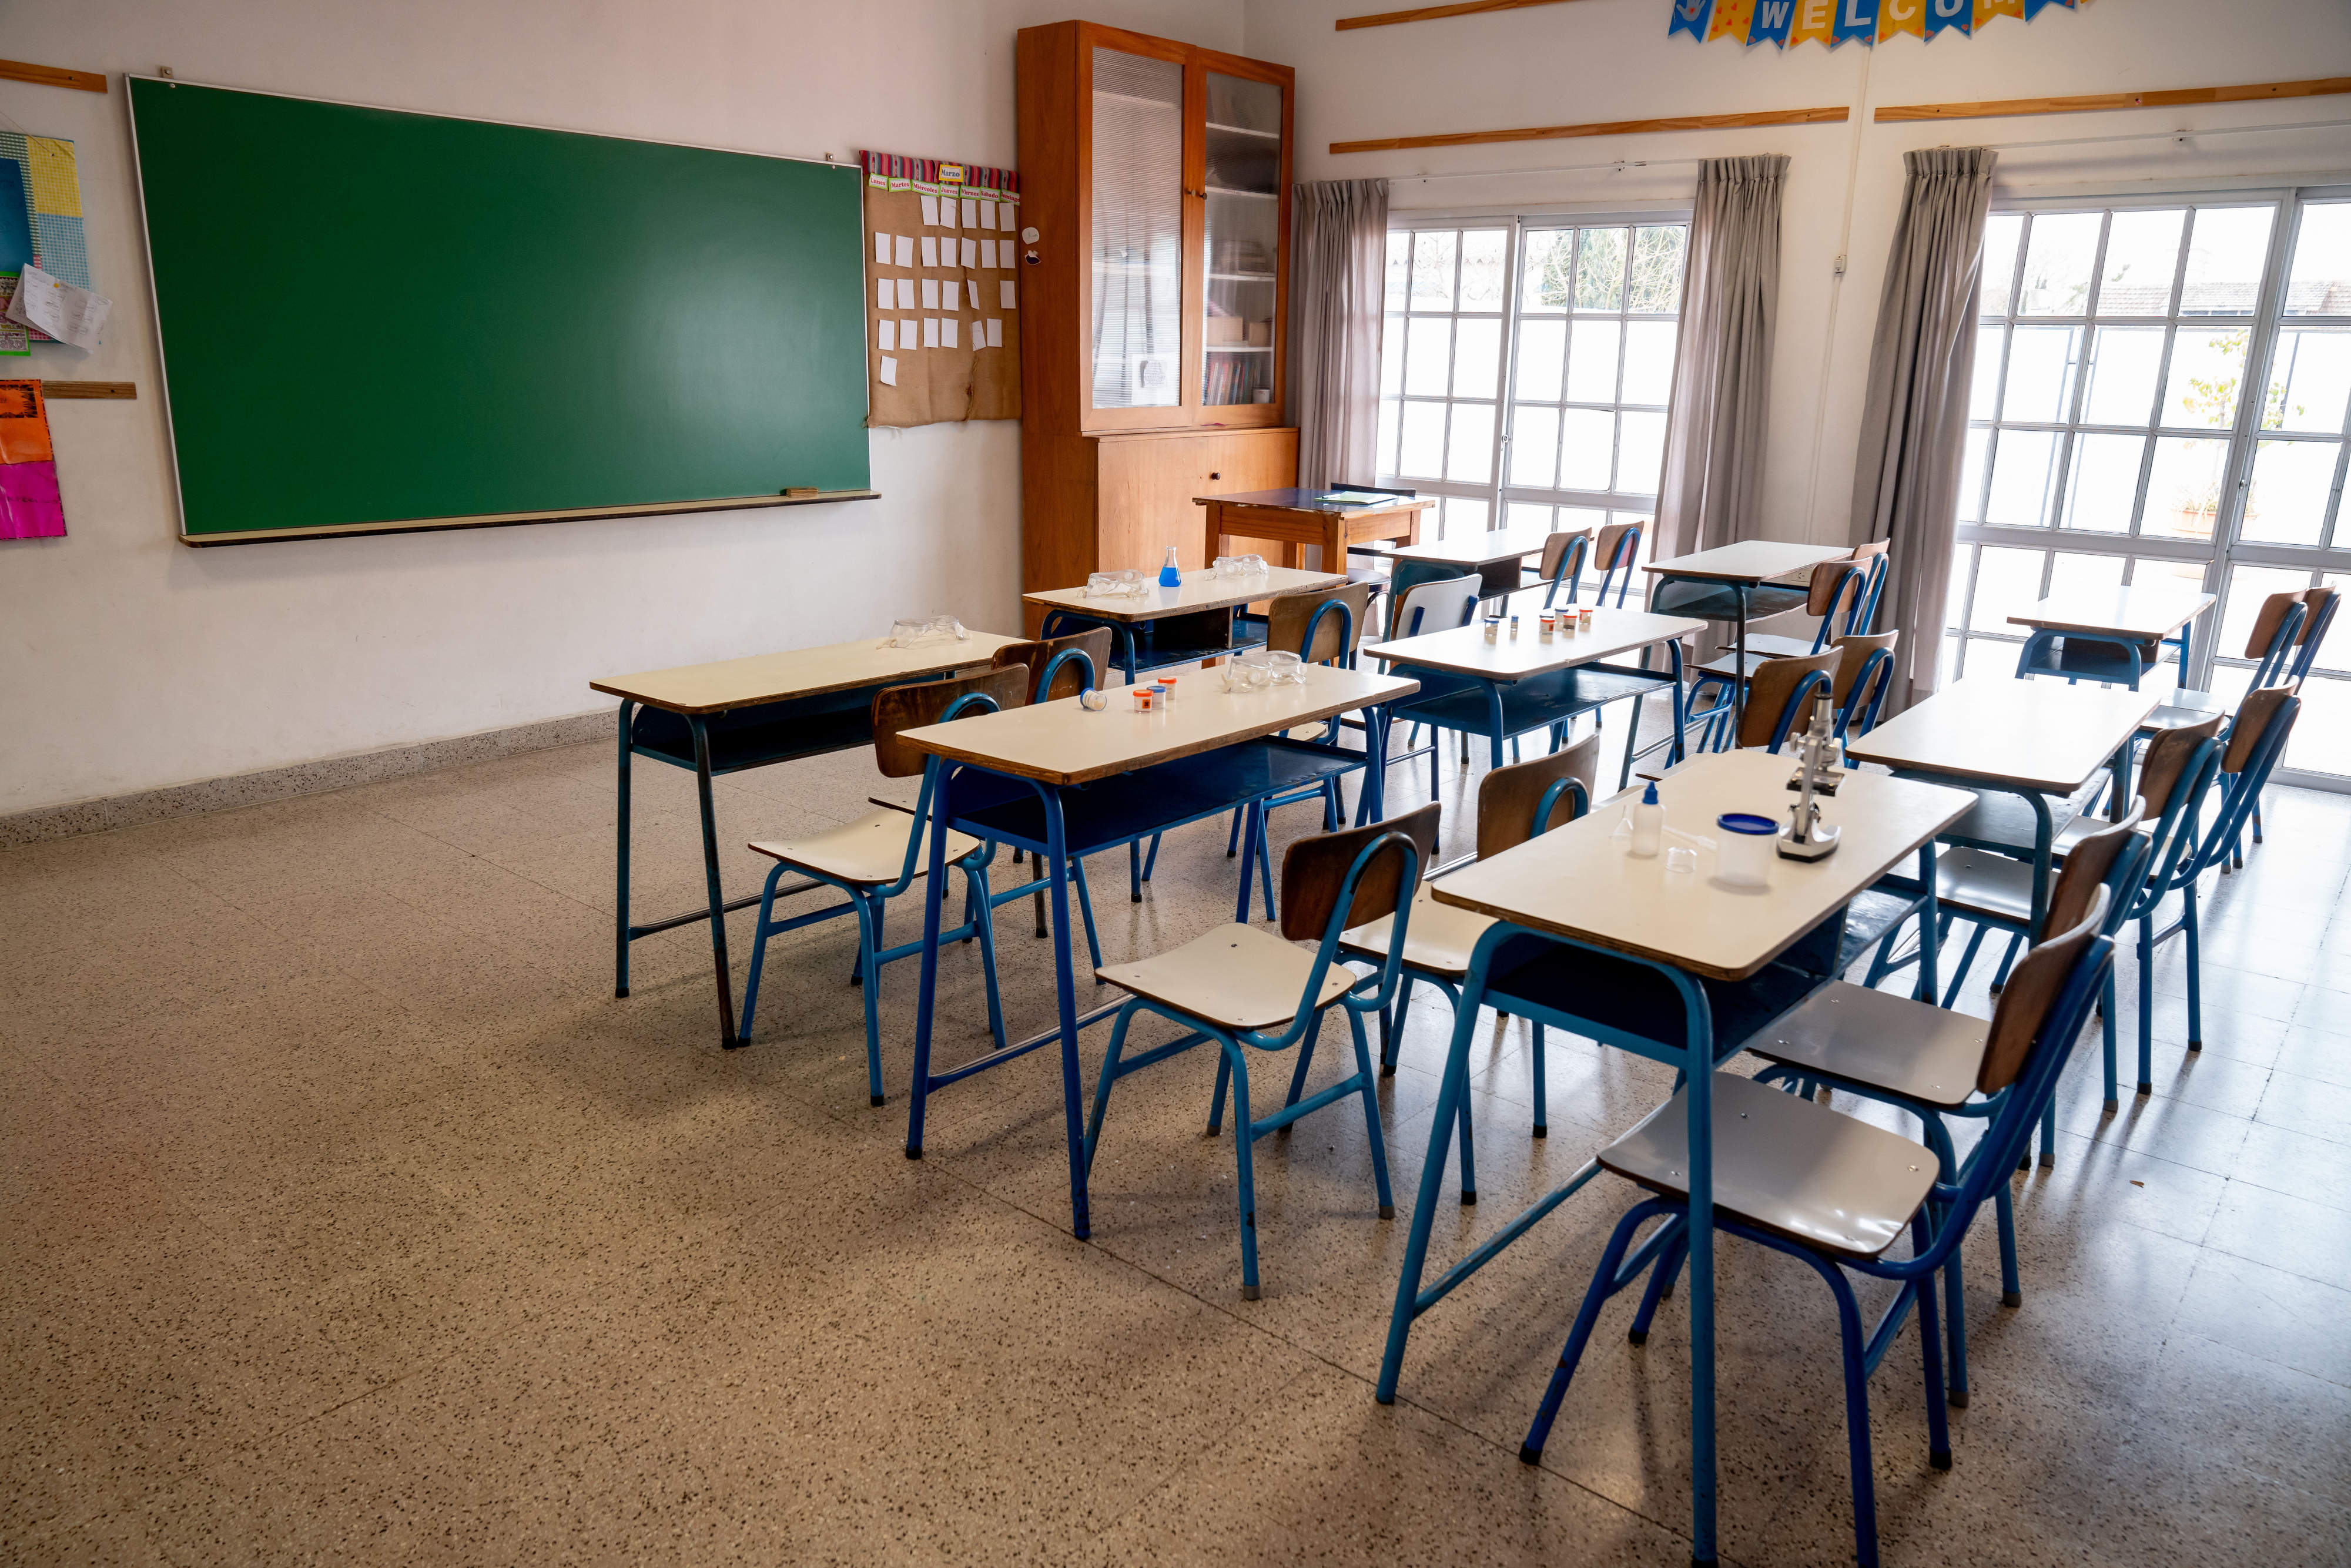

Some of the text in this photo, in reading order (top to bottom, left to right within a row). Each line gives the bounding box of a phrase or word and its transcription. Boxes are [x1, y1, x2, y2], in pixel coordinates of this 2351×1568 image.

[941, 169, 960, 177] Marzo
[870, 177, 886, 186] Lunes
[913, 183, 937, 193] Miércoles
